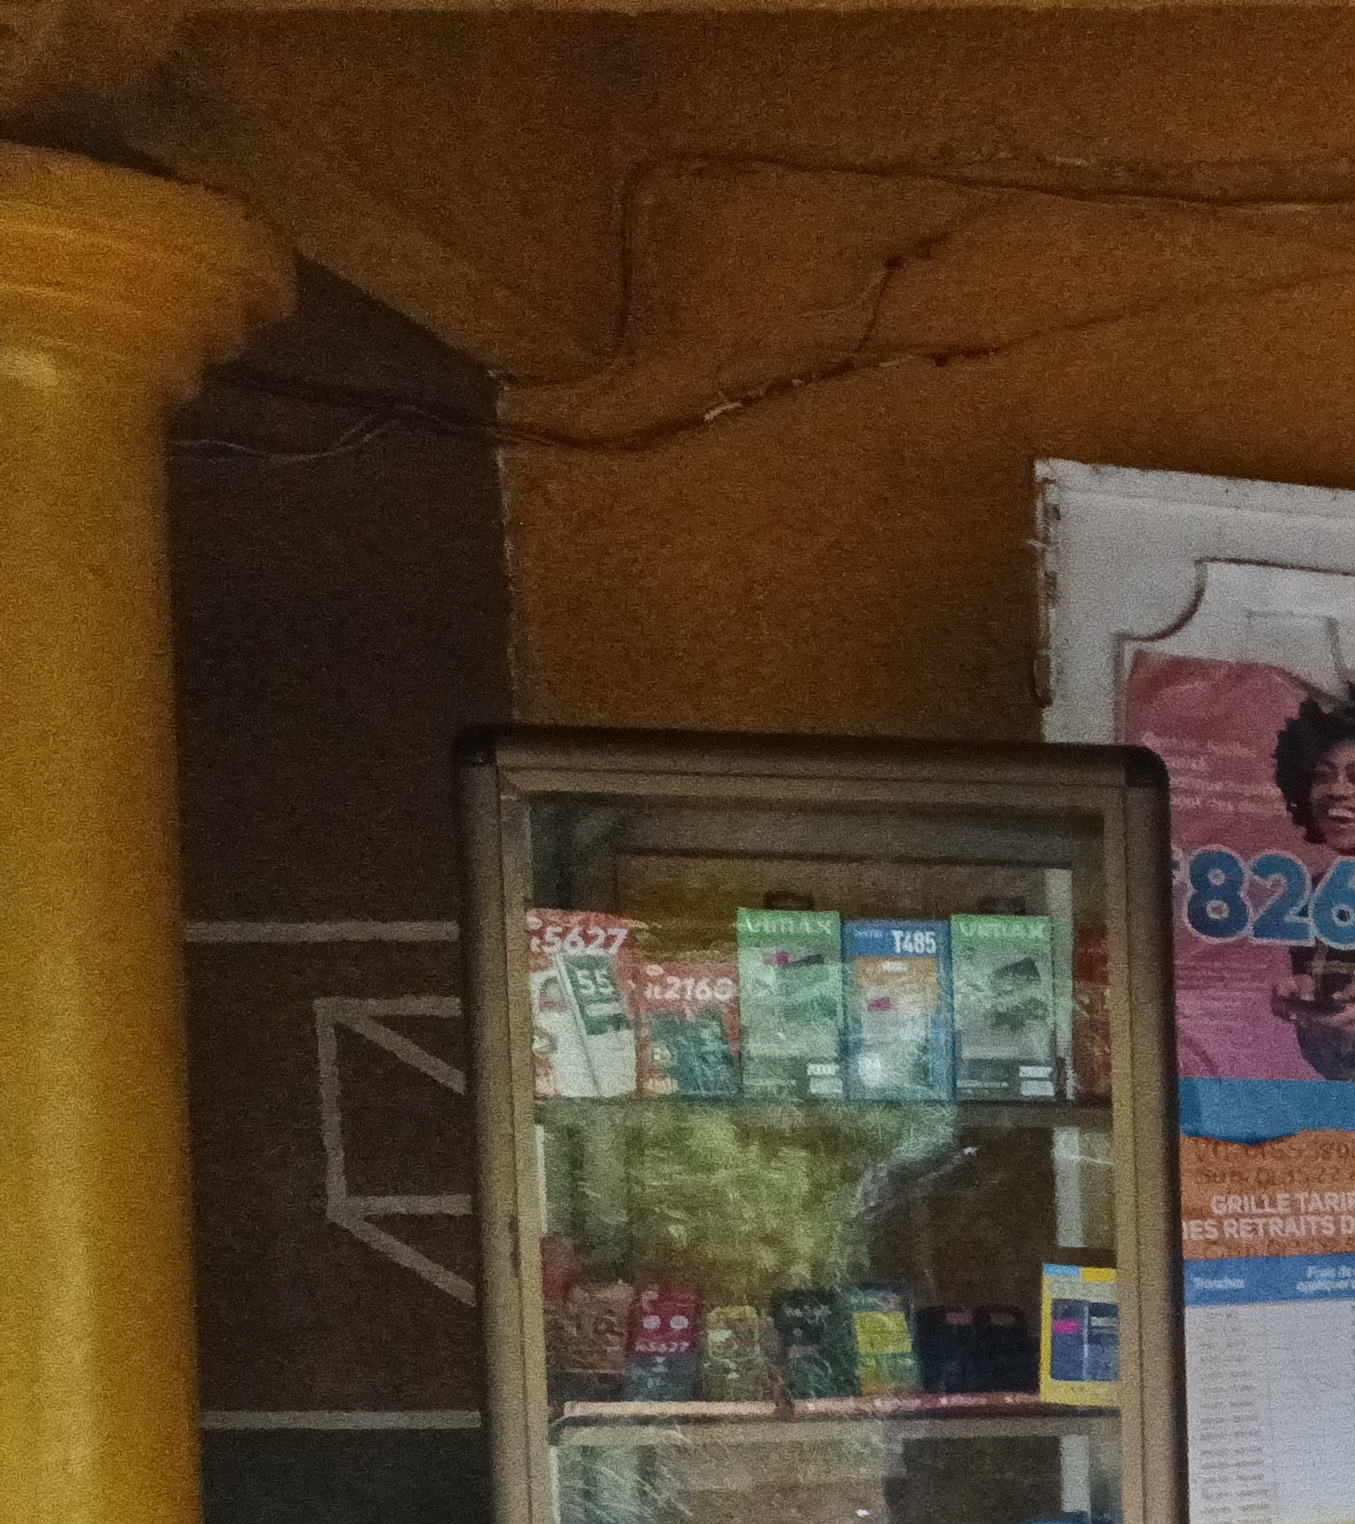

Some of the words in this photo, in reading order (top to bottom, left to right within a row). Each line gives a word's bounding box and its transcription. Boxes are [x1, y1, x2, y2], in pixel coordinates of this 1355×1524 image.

[891, 929, 937, 954] T485
[1210, 1193, 1291, 1216] GRILLE
[1224, 1214, 1335, 1240] RETRAITS
